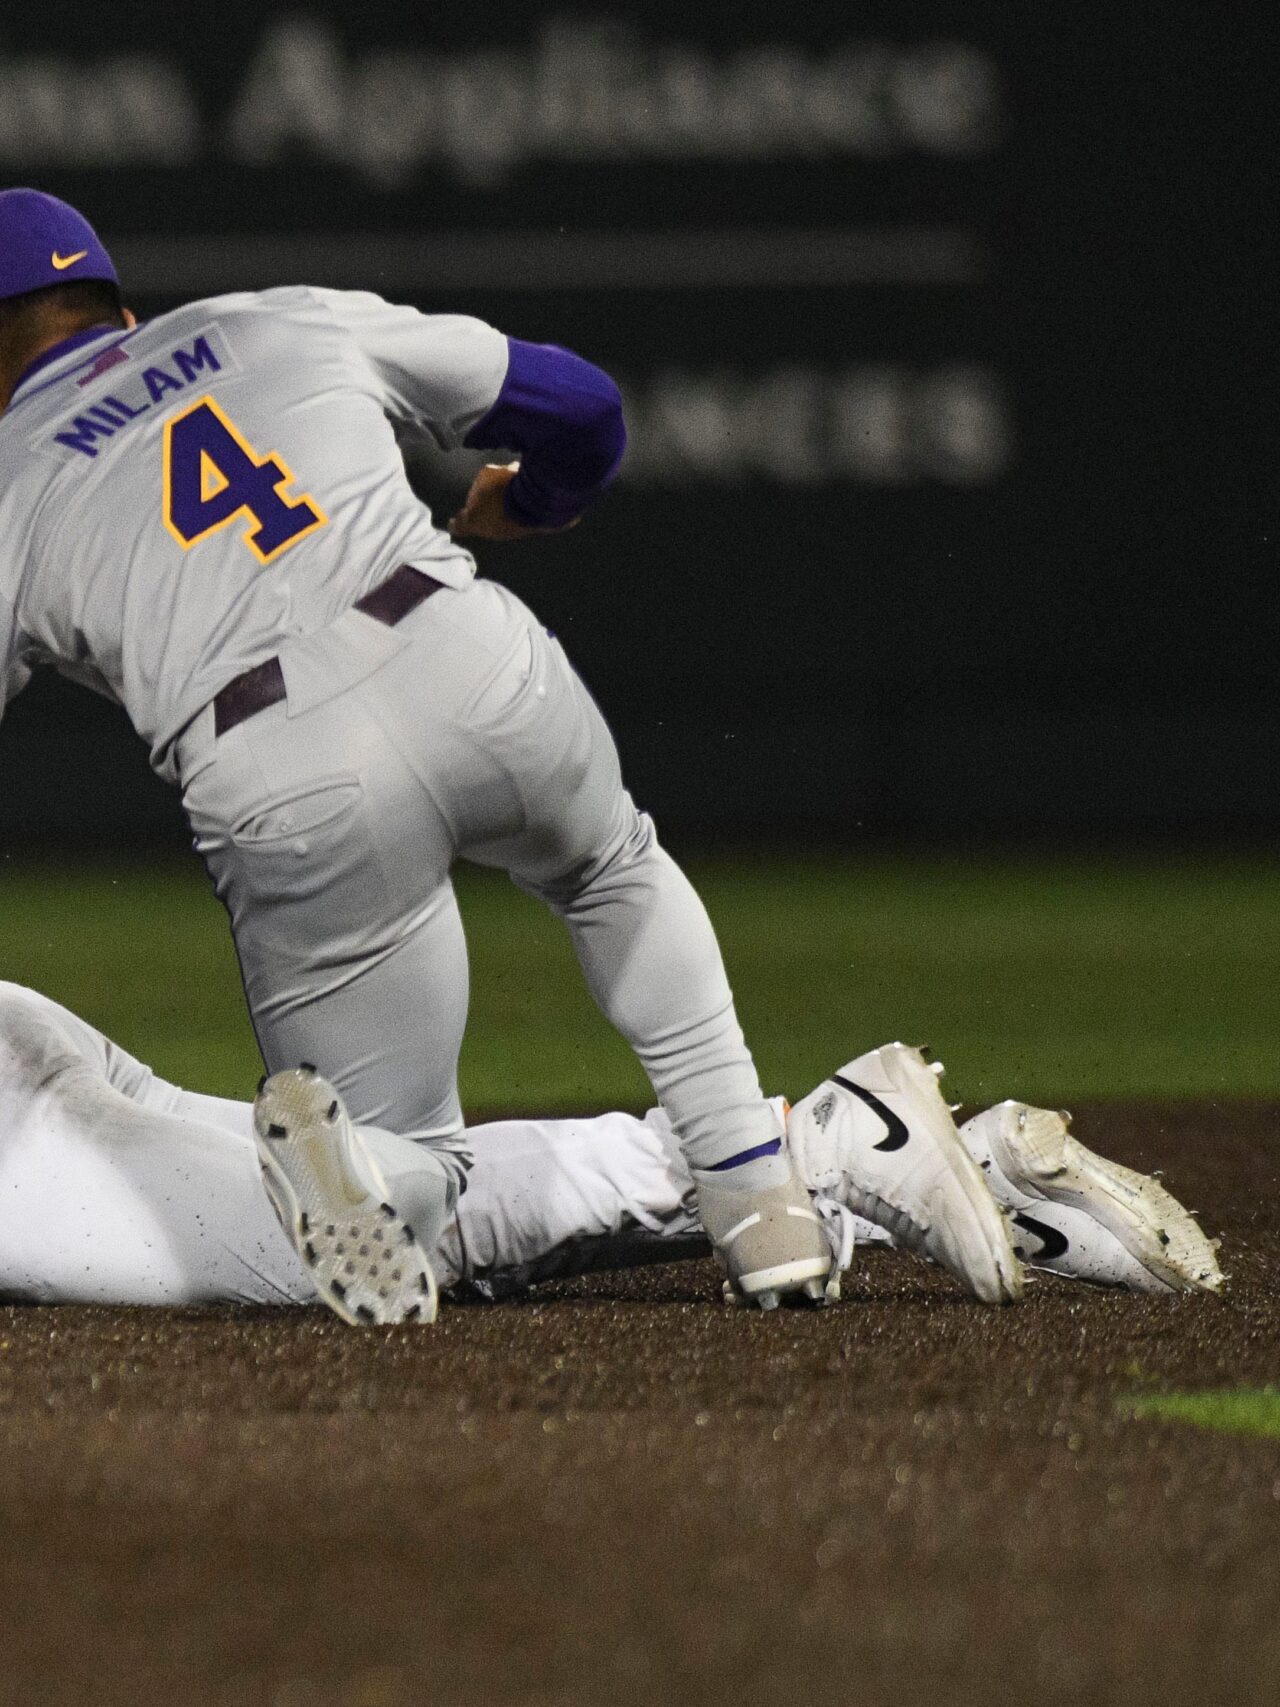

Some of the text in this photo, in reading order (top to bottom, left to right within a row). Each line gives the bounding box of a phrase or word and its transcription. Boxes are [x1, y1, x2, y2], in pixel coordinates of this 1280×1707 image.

[232, 20, 996, 186] Appliance
[53, 335, 221, 458] MILAM
[162, 395, 329, 565] 4
